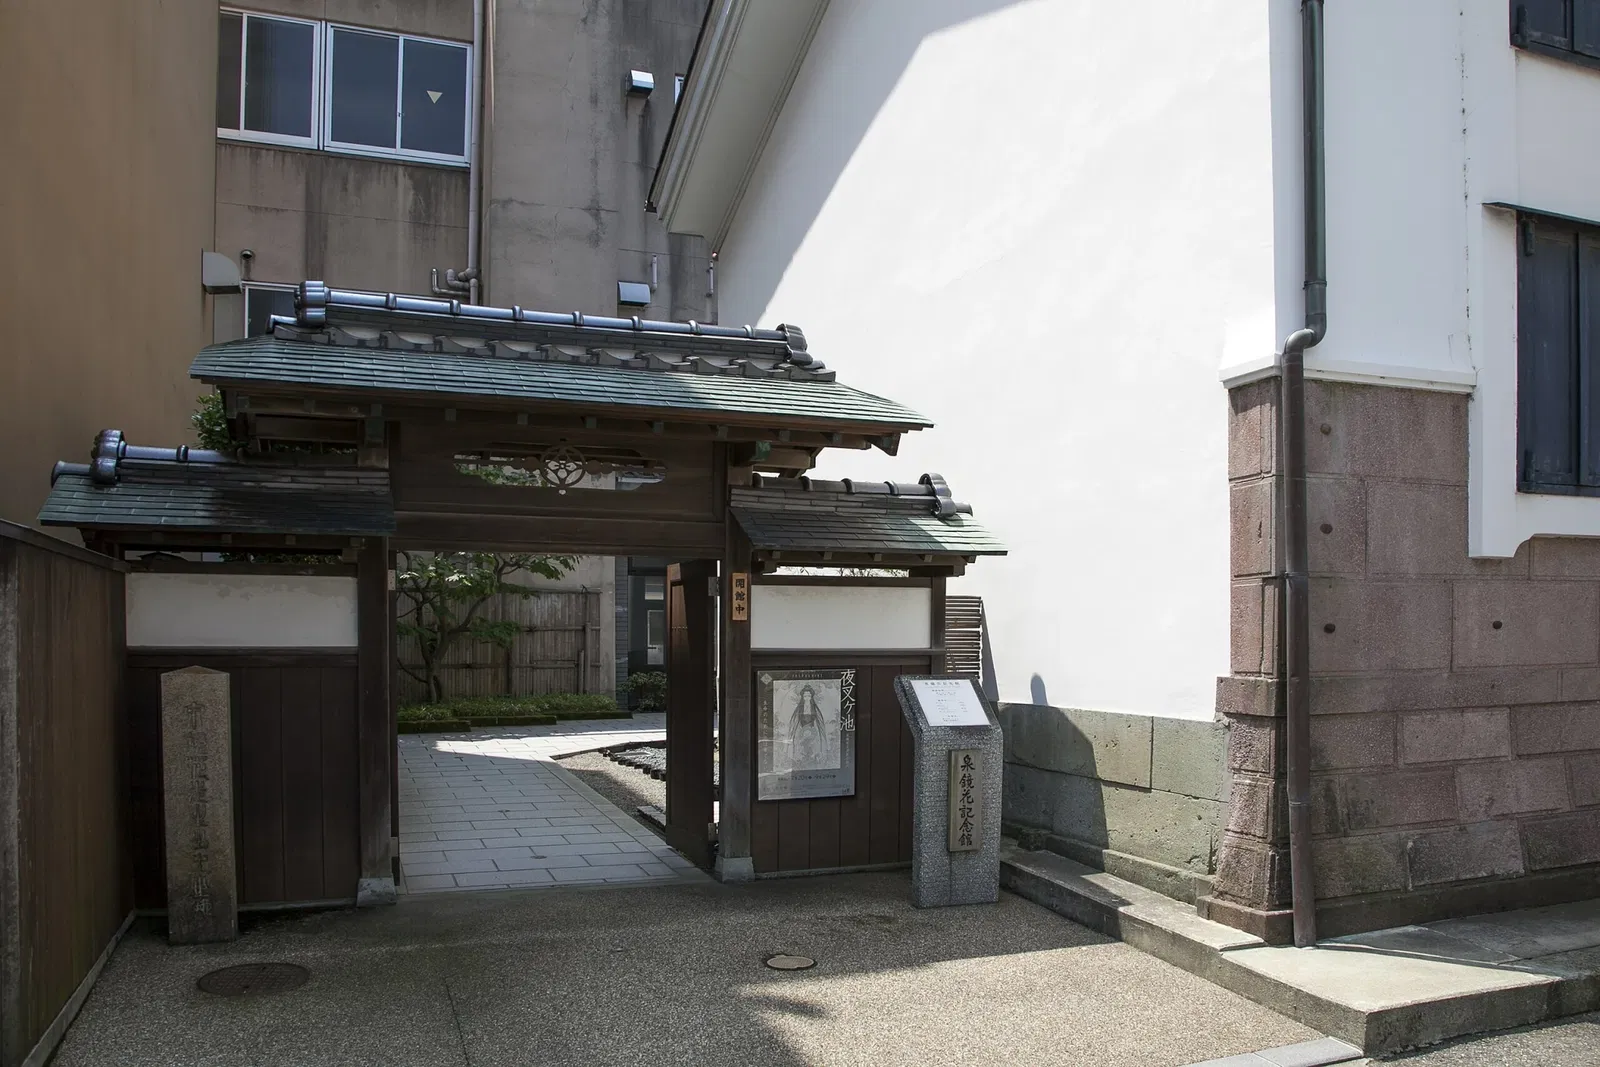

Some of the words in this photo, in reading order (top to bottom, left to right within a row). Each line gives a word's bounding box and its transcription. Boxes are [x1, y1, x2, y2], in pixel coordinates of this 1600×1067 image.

[735, 578, 746, 615] 開館中
[958, 754, 976, 847] 泉鏡花記念館
